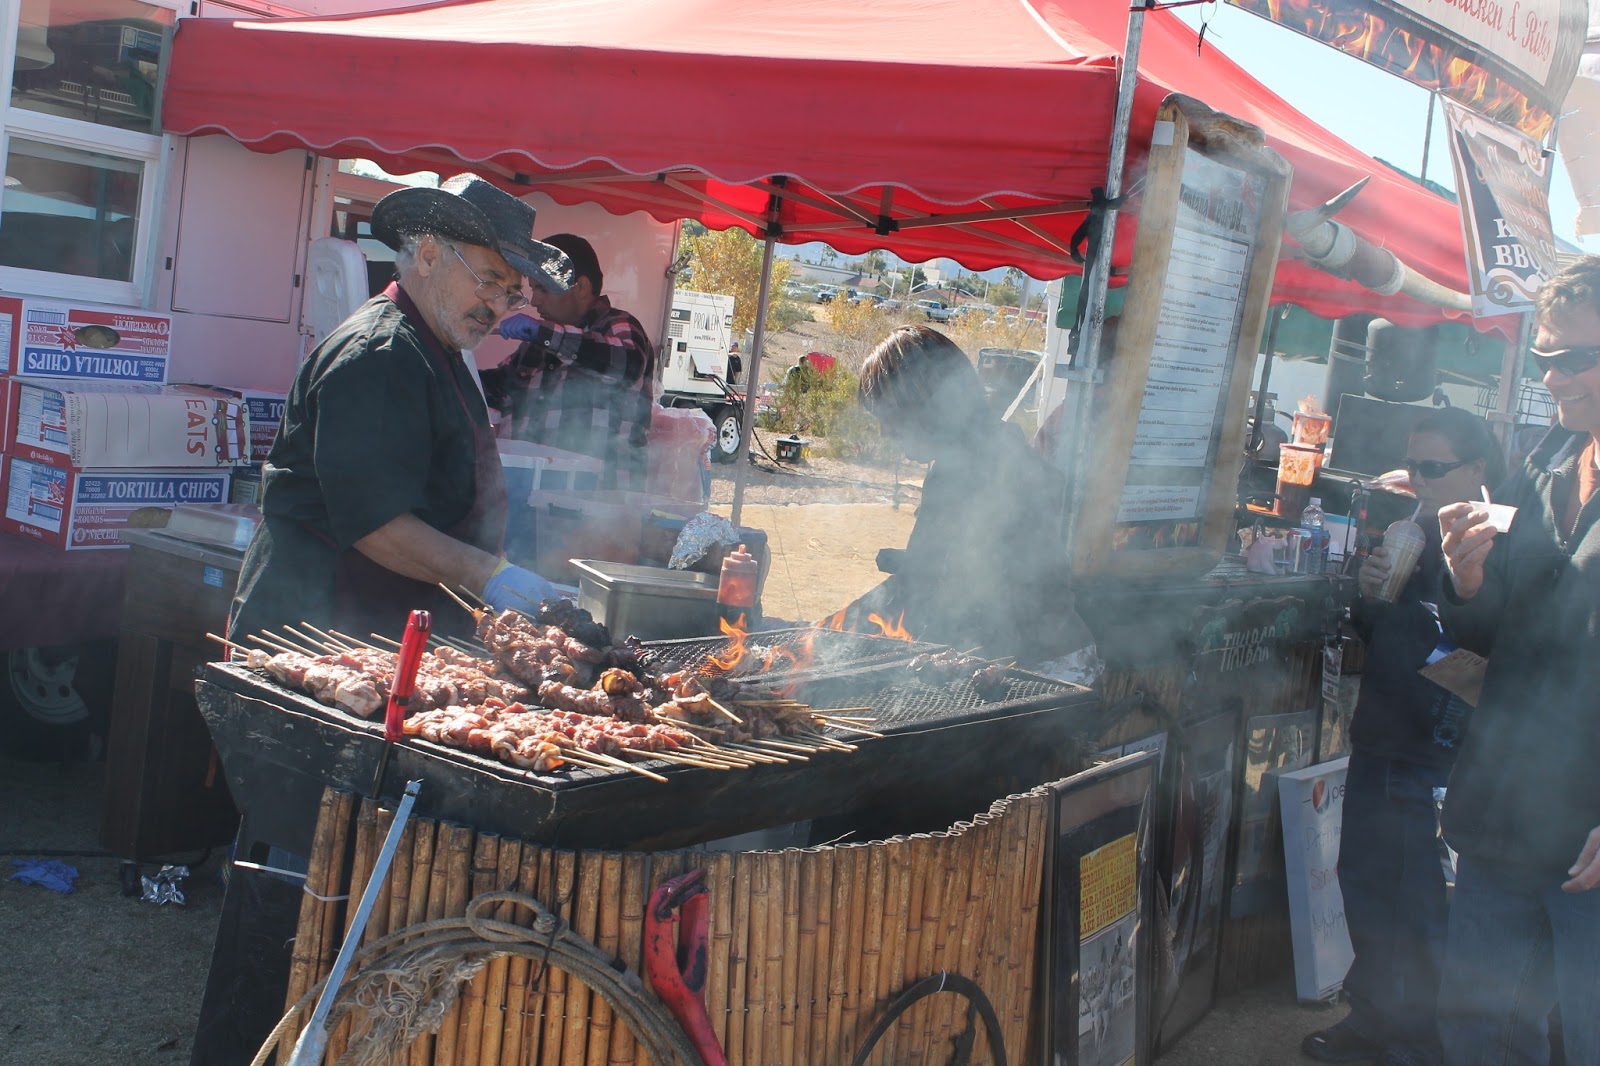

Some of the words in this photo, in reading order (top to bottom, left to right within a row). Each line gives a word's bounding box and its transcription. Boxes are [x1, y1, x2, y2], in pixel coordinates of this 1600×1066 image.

[1452, 0, 1503, 32] icken
[1521, 10, 1552, 62] Ribs
[27, 352, 71, 372] CHIPS
[75, 355, 140, 377] TORTILLA
[184, 399, 208, 458] EATS
[107, 481, 175, 499] TORTILLA
[179, 481, 220, 499] CHIPS
[87, 528, 119, 540] Medall
